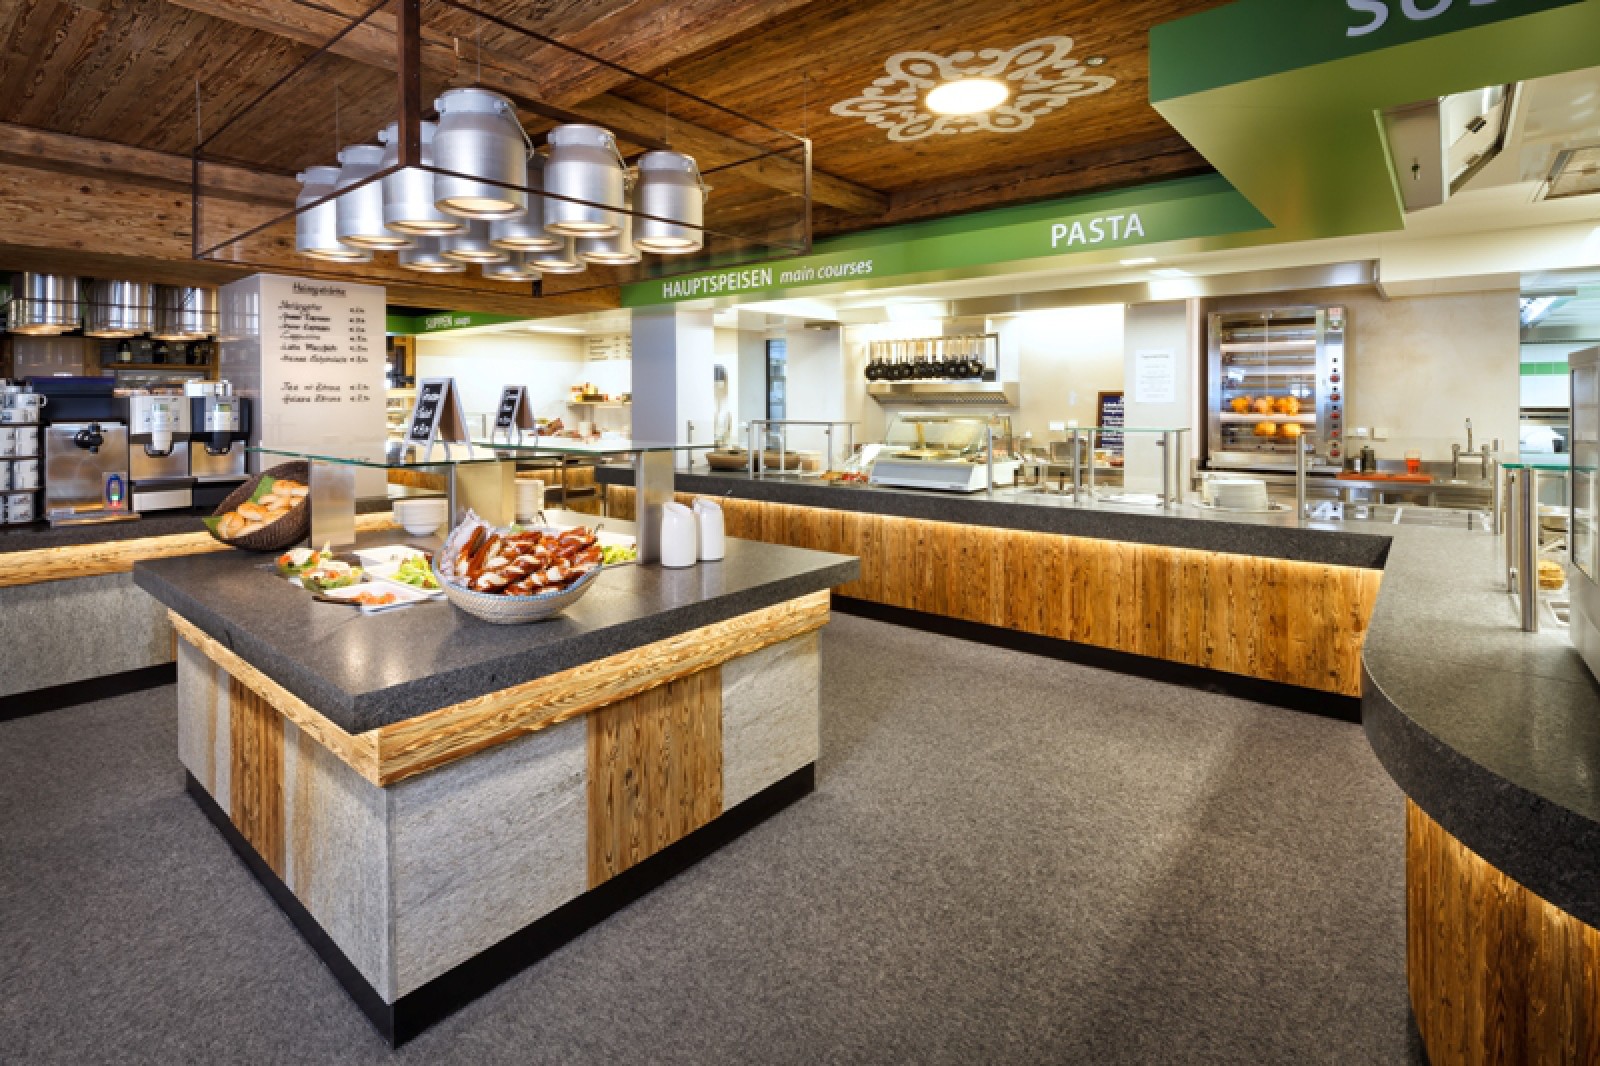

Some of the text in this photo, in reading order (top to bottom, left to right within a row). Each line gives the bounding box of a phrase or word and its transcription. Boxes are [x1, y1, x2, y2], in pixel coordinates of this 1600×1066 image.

[1051, 213, 1145, 249] PASTA
[662, 259, 873, 299] HAUPTSPEISEN main courses
